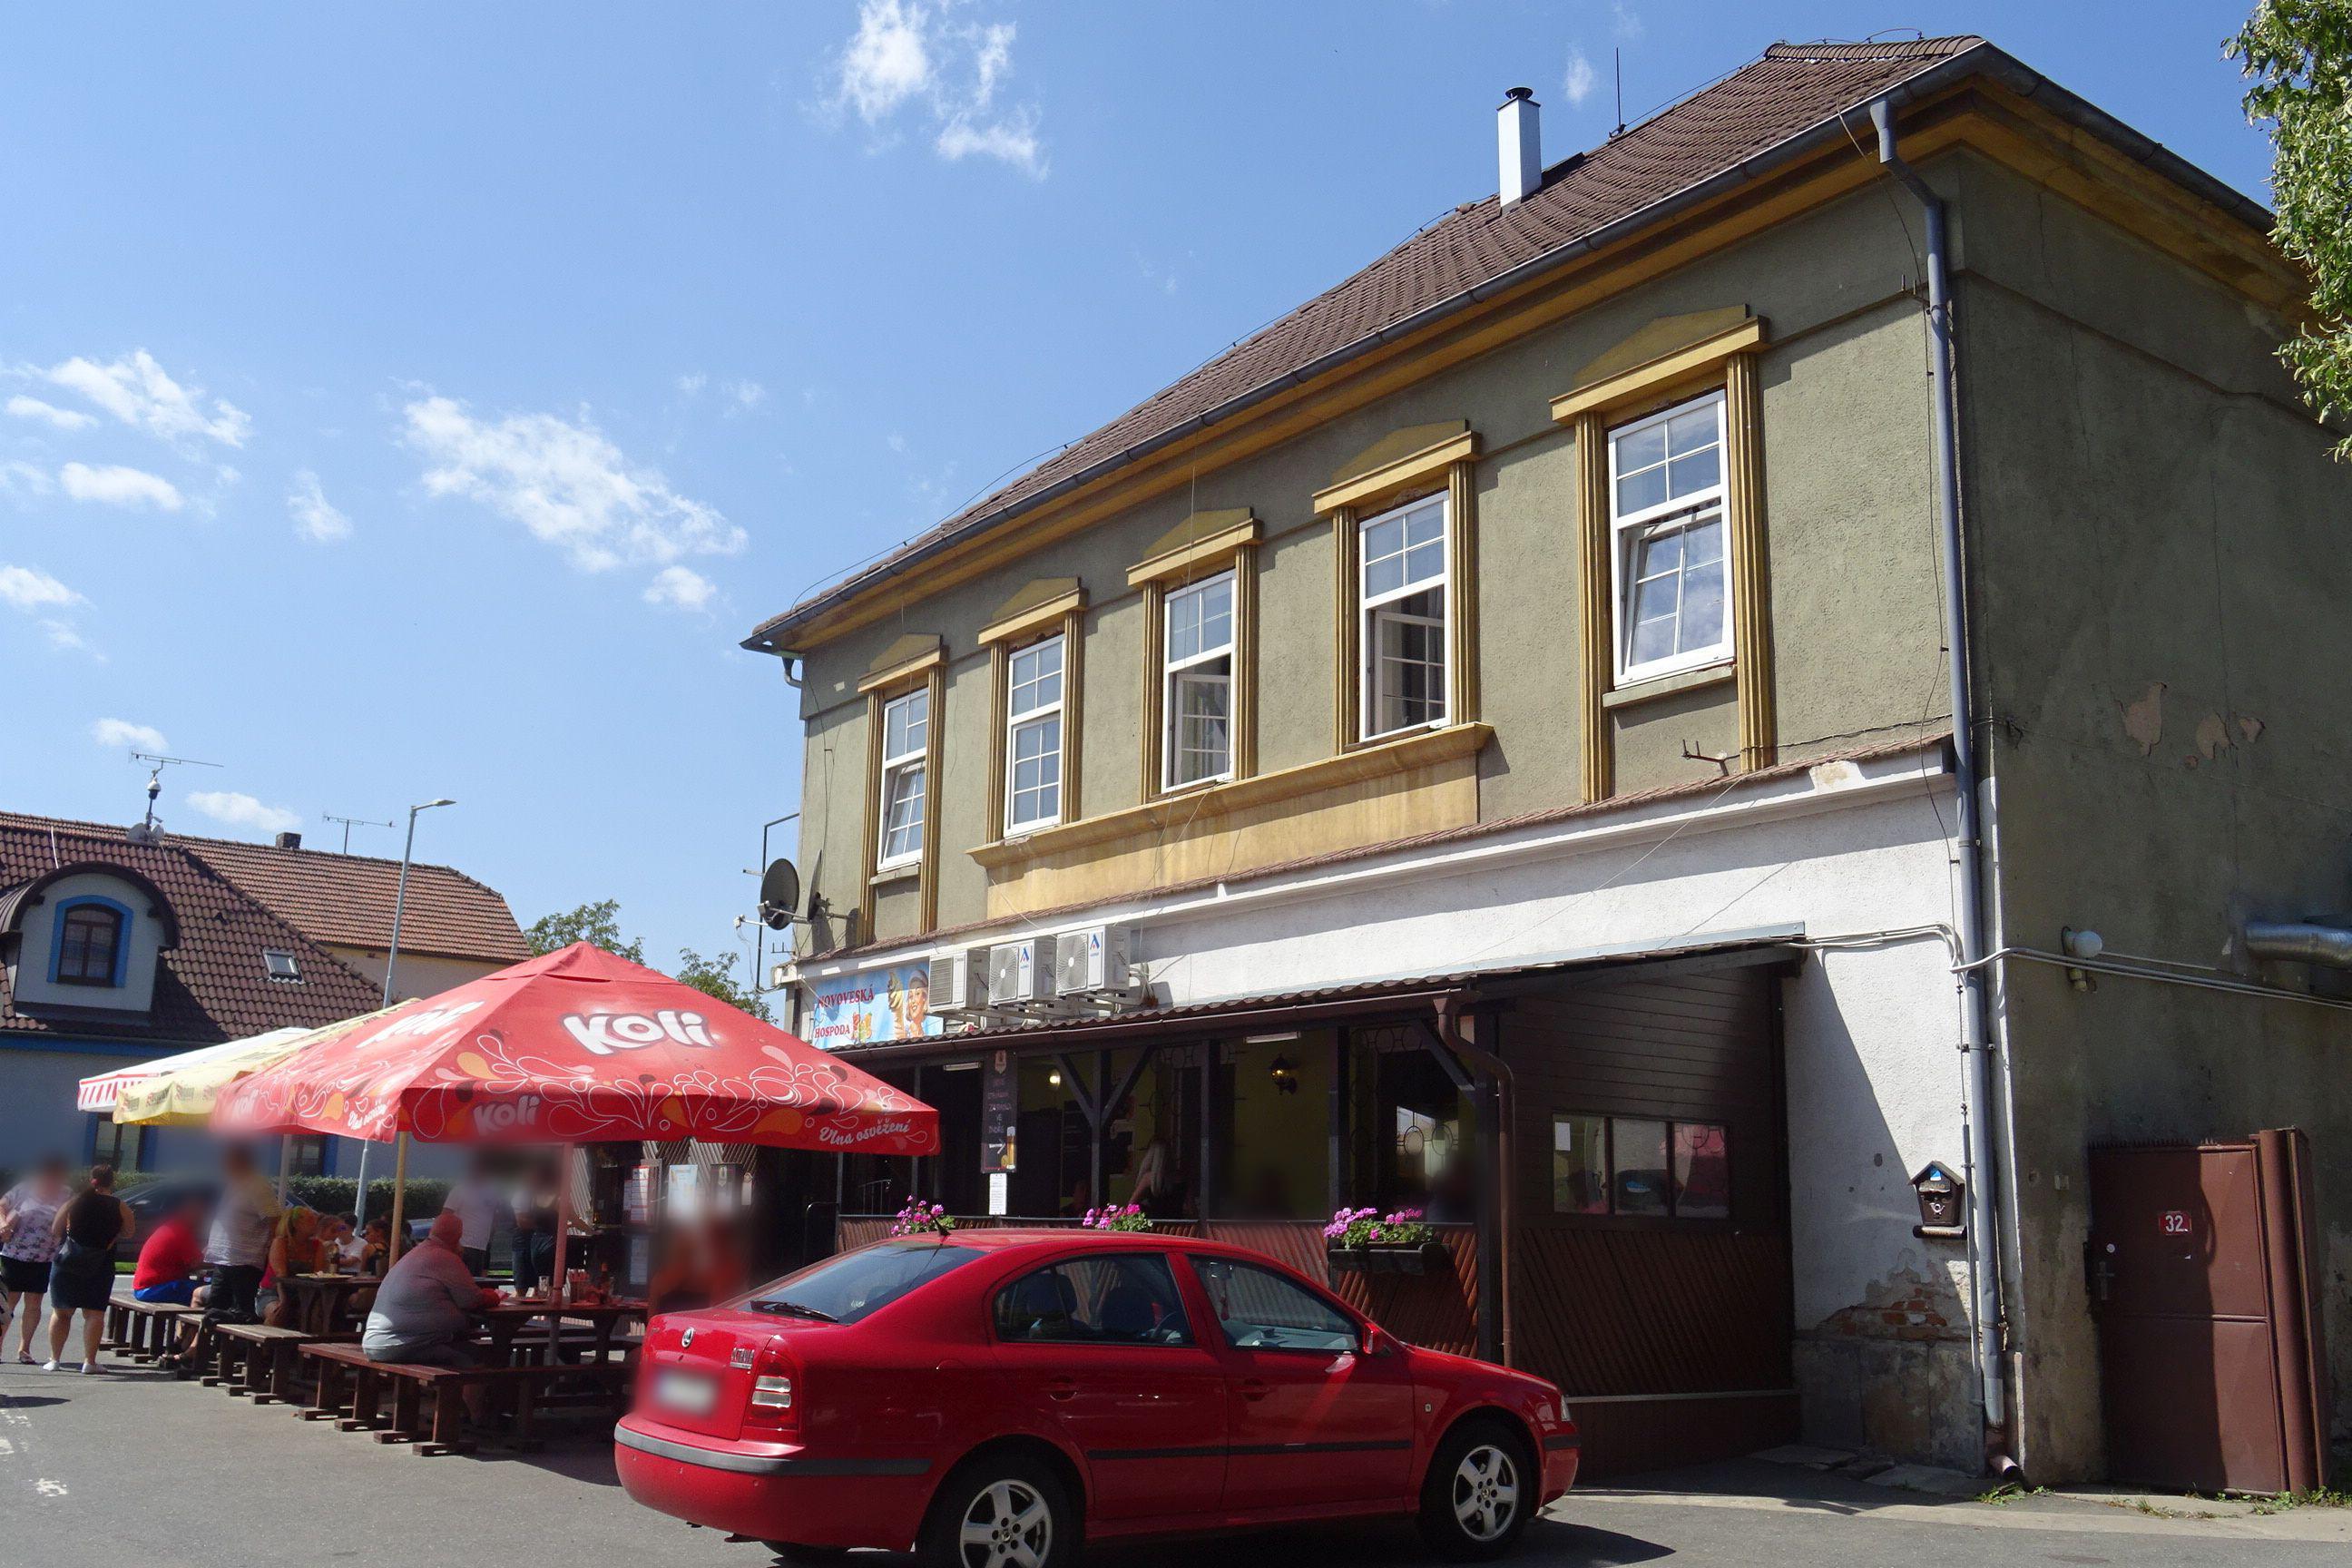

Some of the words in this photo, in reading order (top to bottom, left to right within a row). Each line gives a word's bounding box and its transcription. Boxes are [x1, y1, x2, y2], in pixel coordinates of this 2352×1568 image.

[818, 984, 874, 1008] NOVOVESKÁ
[814, 1024, 850, 1039] HOSPODA
[856, 1118, 911, 1141] osvěžení
[2165, 1214, 2185, 1232] 32
